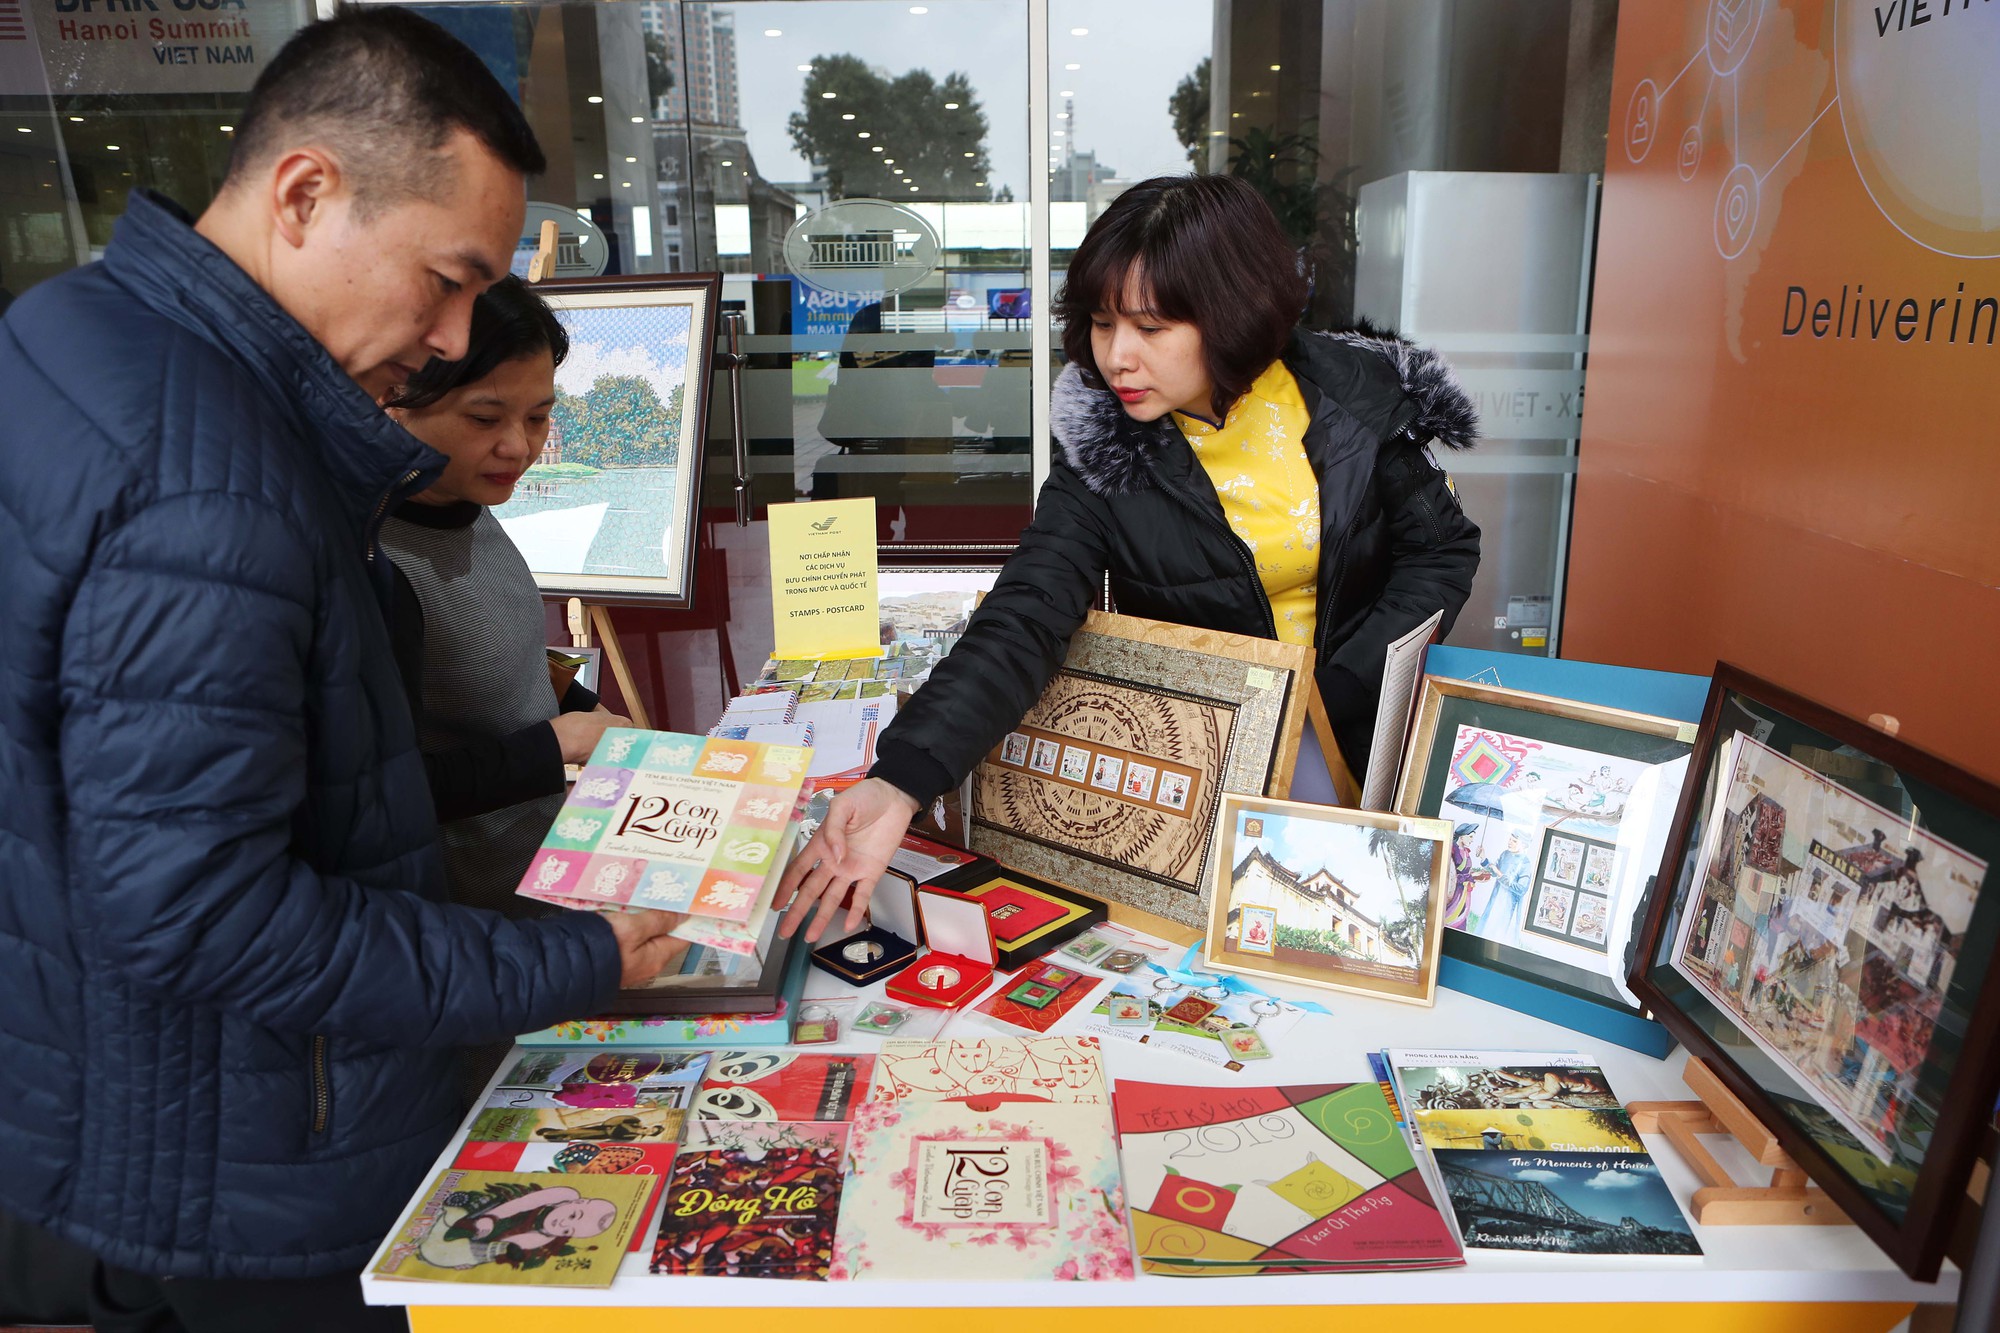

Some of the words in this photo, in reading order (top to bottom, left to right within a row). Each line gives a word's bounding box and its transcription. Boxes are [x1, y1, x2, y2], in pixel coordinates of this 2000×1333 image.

[58, 19, 138, 41] Hanoi
[149, 16, 250, 40] Summit
[1874, 0, 1991, 38] VIE
[152, 47, 200, 65] VIET
[206, 45, 254, 64] NAM
[1781, 282, 1999, 345] Deliverin
[805, 563, 818, 571] CÁC
[785, 587, 808, 595] TRONG
[789, 608, 820, 618] STAMPS
[826, 604, 865, 614] POSTCARD
[673, 799, 723, 827] Con
[1136, 1105, 1179, 1128] TẾT
[1163, 1114, 1295, 1159] 2019
[1507, 1157, 1531, 1167] The
[1532, 1157, 1593, 1169] Moments
[1595, 1160, 1609, 1171] of
[1613, 1159, 1650, 1170] Hanoi
[674, 1188, 762, 1225] Đông
[764, 1185, 819, 1213] Hồ
[1299, 1227, 1332, 1246] Year
[1327, 1217, 1350, 1230] Of
[1341, 1205, 1370, 1221] The
[1365, 1195, 1393, 1210] Pig
